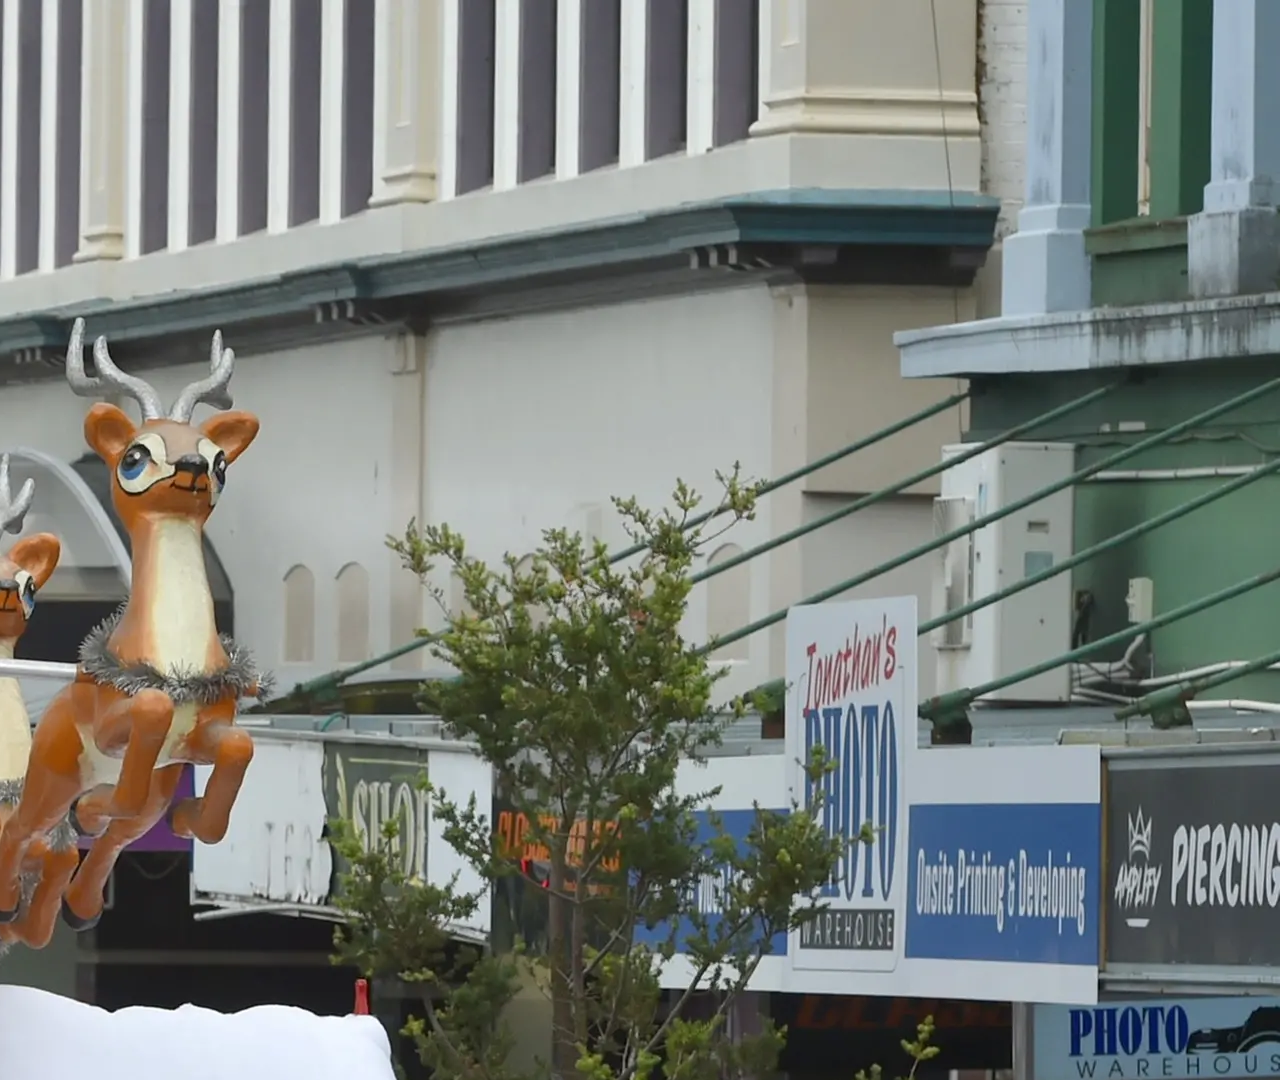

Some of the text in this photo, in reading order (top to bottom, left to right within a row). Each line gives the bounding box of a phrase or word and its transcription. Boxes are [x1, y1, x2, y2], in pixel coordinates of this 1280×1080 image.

[803, 612, 898, 718] Jonathan's
[801, 700, 898, 902] PHOTO
[916, 848, 1086, 936] Onsite Printing & Developing
[1115, 860, 1162, 910] AMPLIFY
[1170, 822, 1280, 908] PIERCING
[802, 911, 894, 947] WAREHOUSE
[1068, 1004, 1189, 1057] PHOTO
[1076, 1053, 1280, 1078] WAREHOUS
